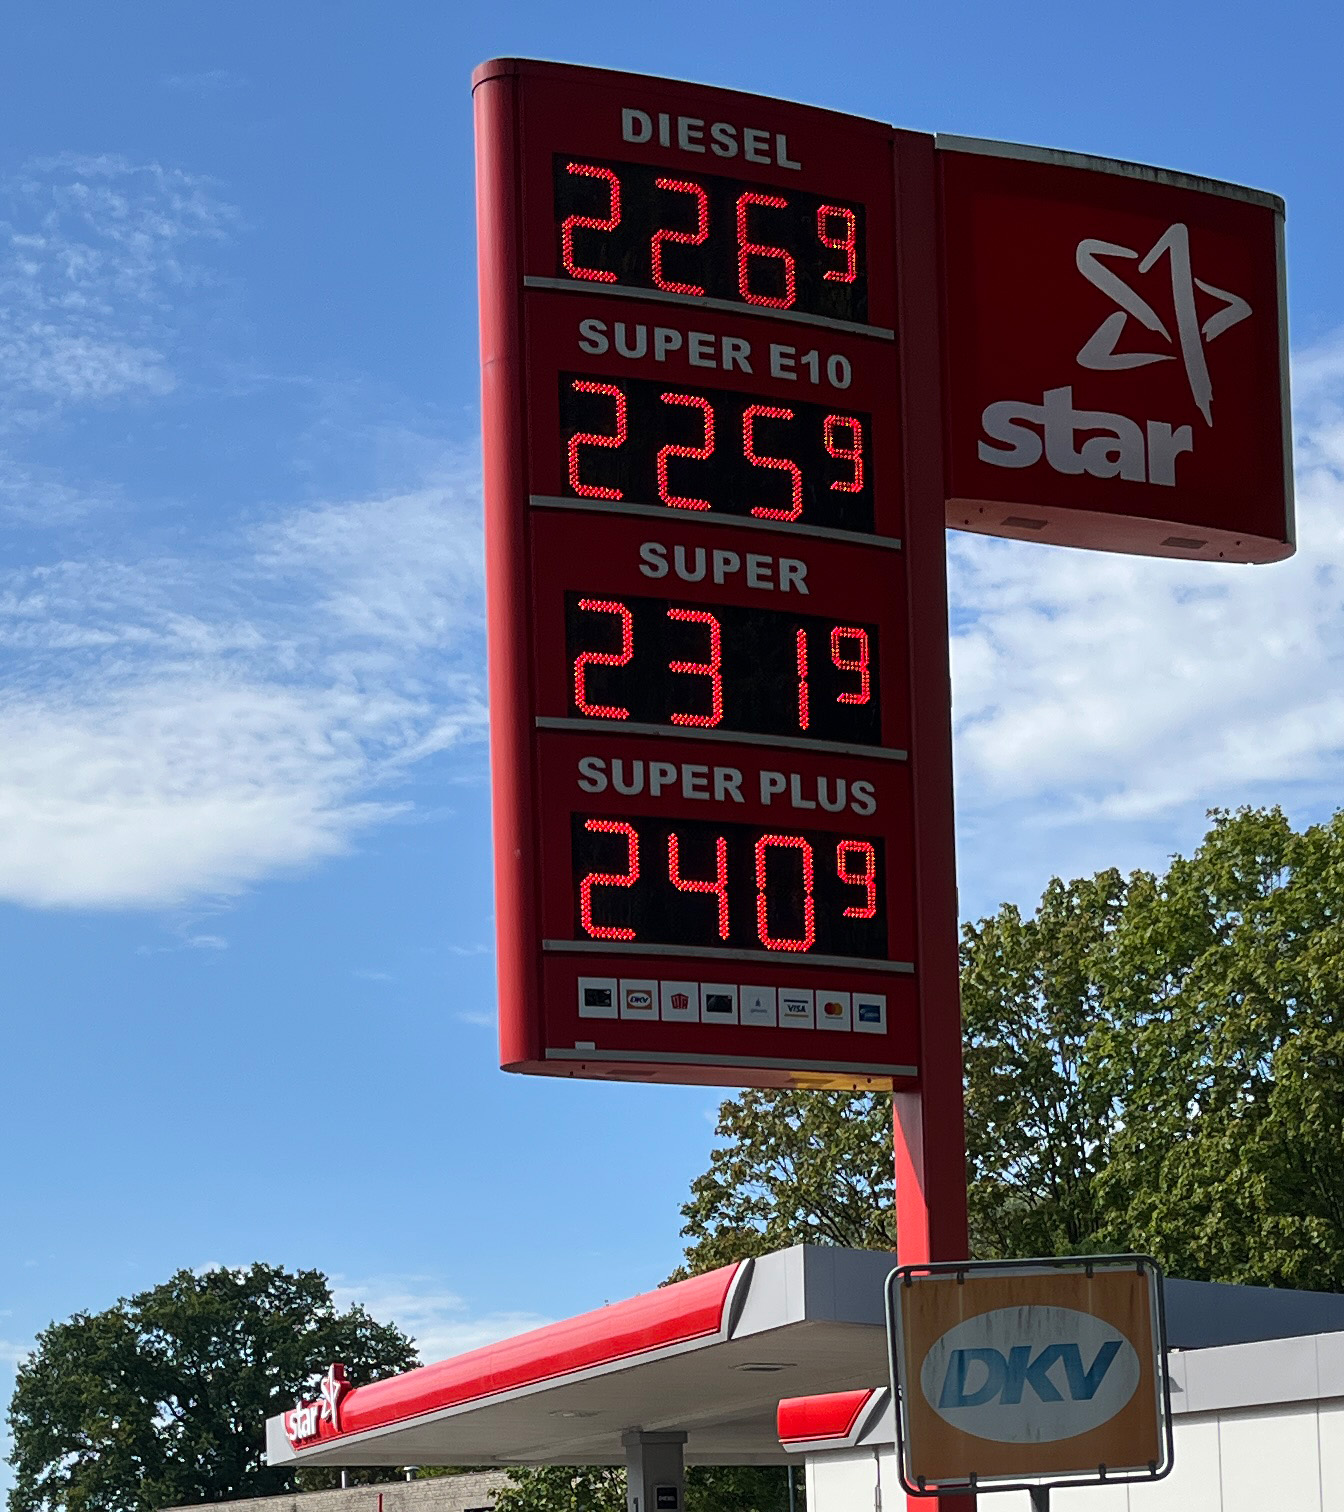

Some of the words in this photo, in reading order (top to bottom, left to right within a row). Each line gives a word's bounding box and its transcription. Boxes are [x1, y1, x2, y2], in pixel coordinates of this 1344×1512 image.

[621, 107, 803, 171] DIESEL
[578, 318, 753, 375] SUPER
[769, 343, 853, 391] E10
[976, 384, 1195, 488] star
[638, 540, 809, 595] SUPER
[577, 756, 745, 803] SUPER
[759, 769, 877, 816] PLUS
[629, 995, 650, 1004] DKV
[787, 1004, 807, 1014] VISA
[938, 1340, 1124, 1409] DKV
[289, 1400, 319, 1441] star
